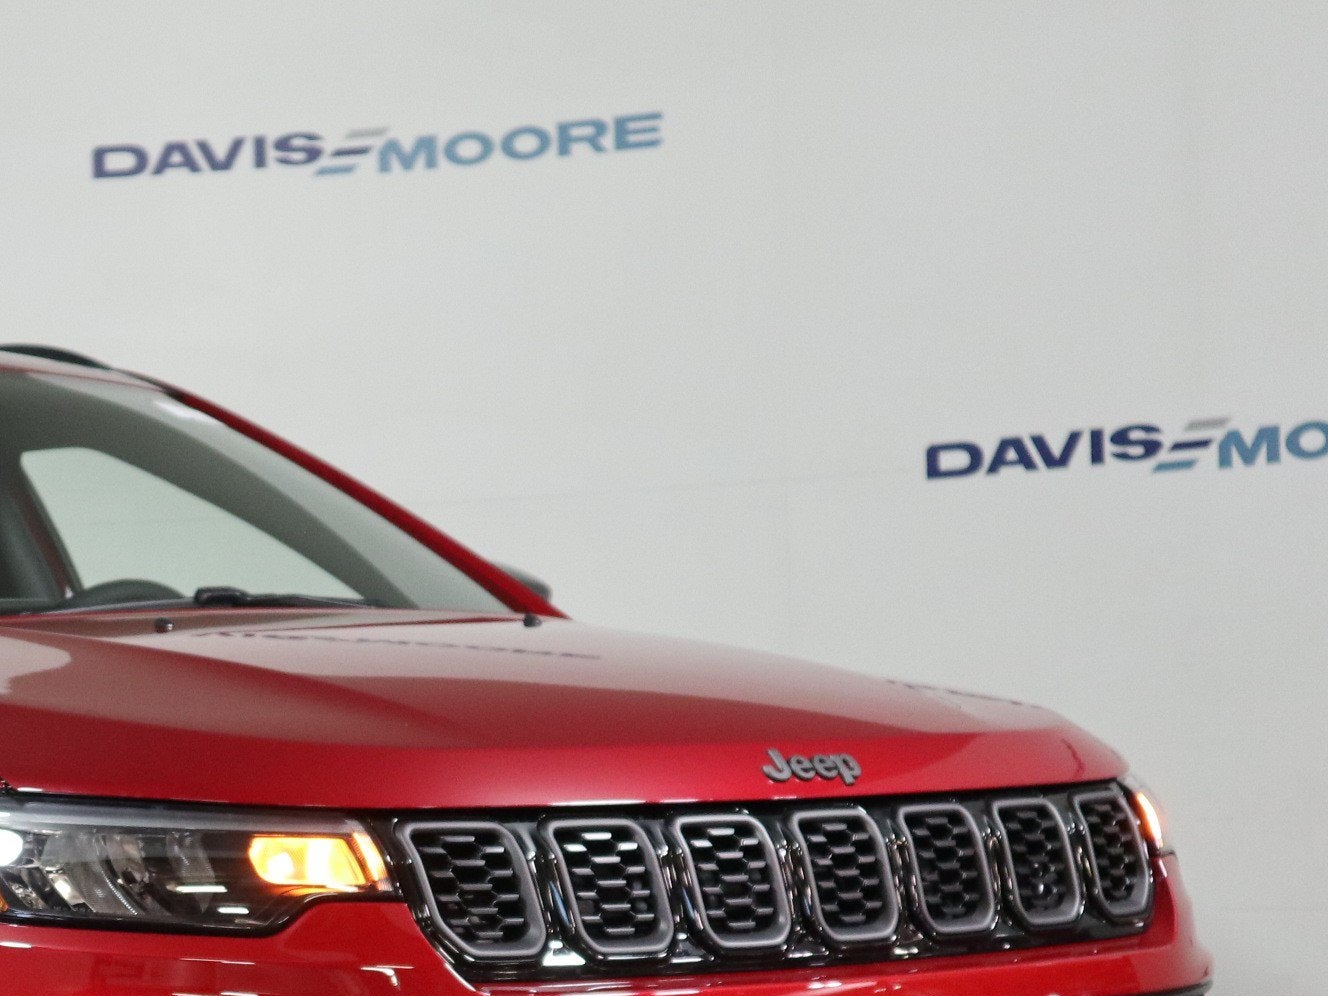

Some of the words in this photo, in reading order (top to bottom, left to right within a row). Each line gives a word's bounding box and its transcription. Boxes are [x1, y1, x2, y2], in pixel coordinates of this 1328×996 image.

[91, 131, 324, 179] DAVIS
[377, 111, 663, 173] MOORE
[925, 423, 1164, 480] DAVIS
[761, 748, 862, 786] Jeep
